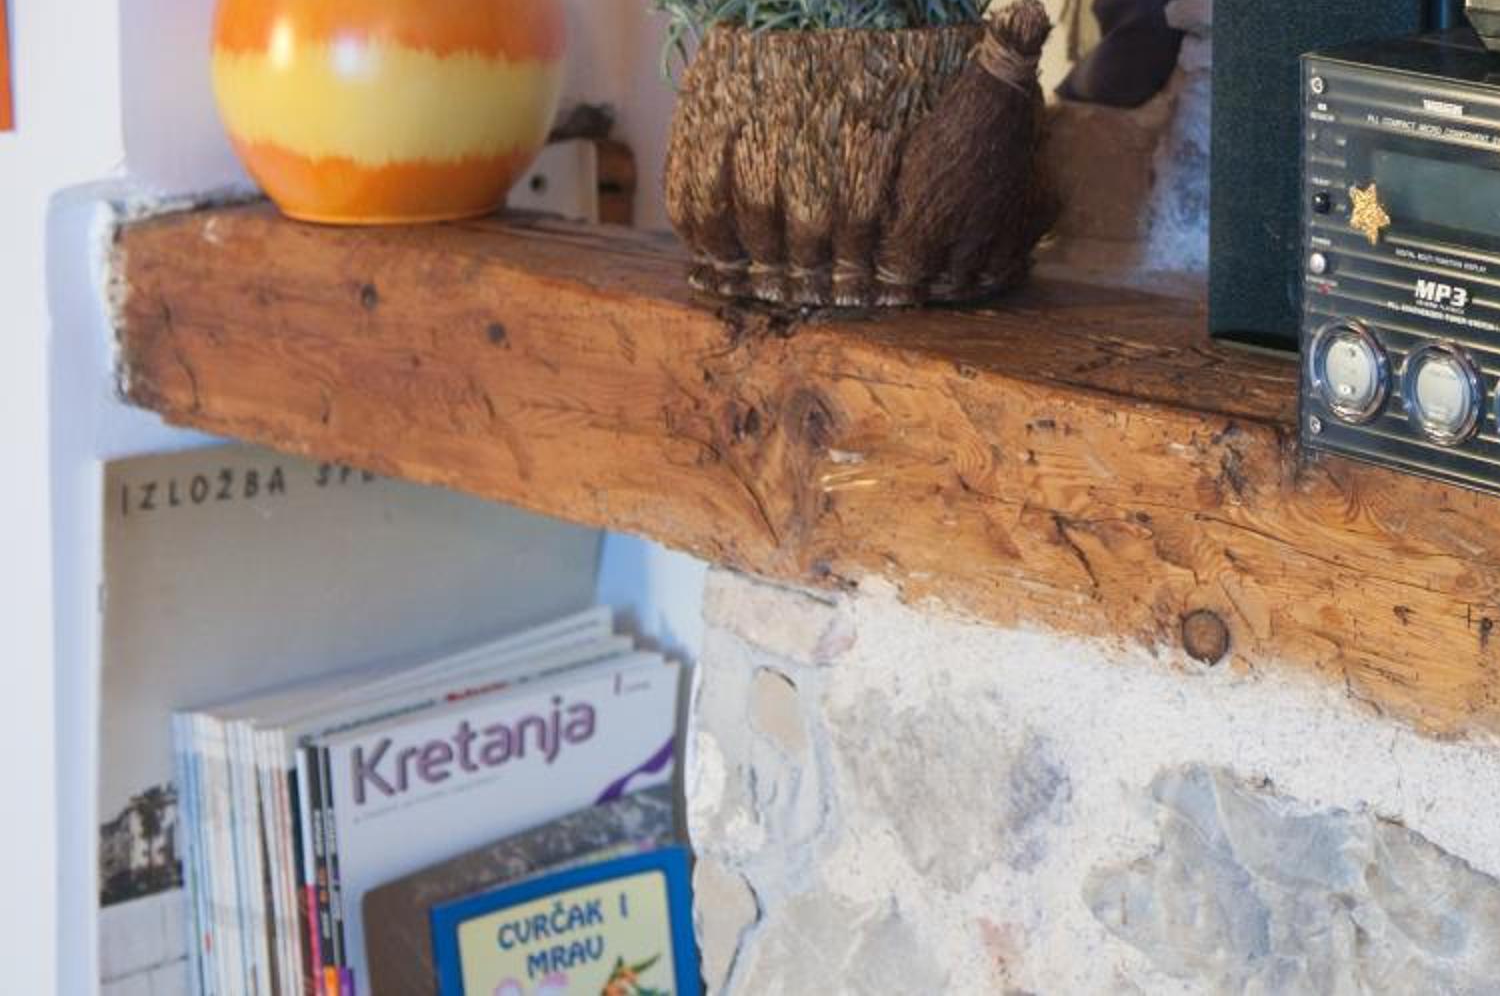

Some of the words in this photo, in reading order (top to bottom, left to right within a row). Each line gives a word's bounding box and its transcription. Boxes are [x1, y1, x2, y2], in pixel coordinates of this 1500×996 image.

[1415, 278, 1468, 308] MP3
[352, 695, 598, 806] Kretanja
[618, 891, 628, 919] I
